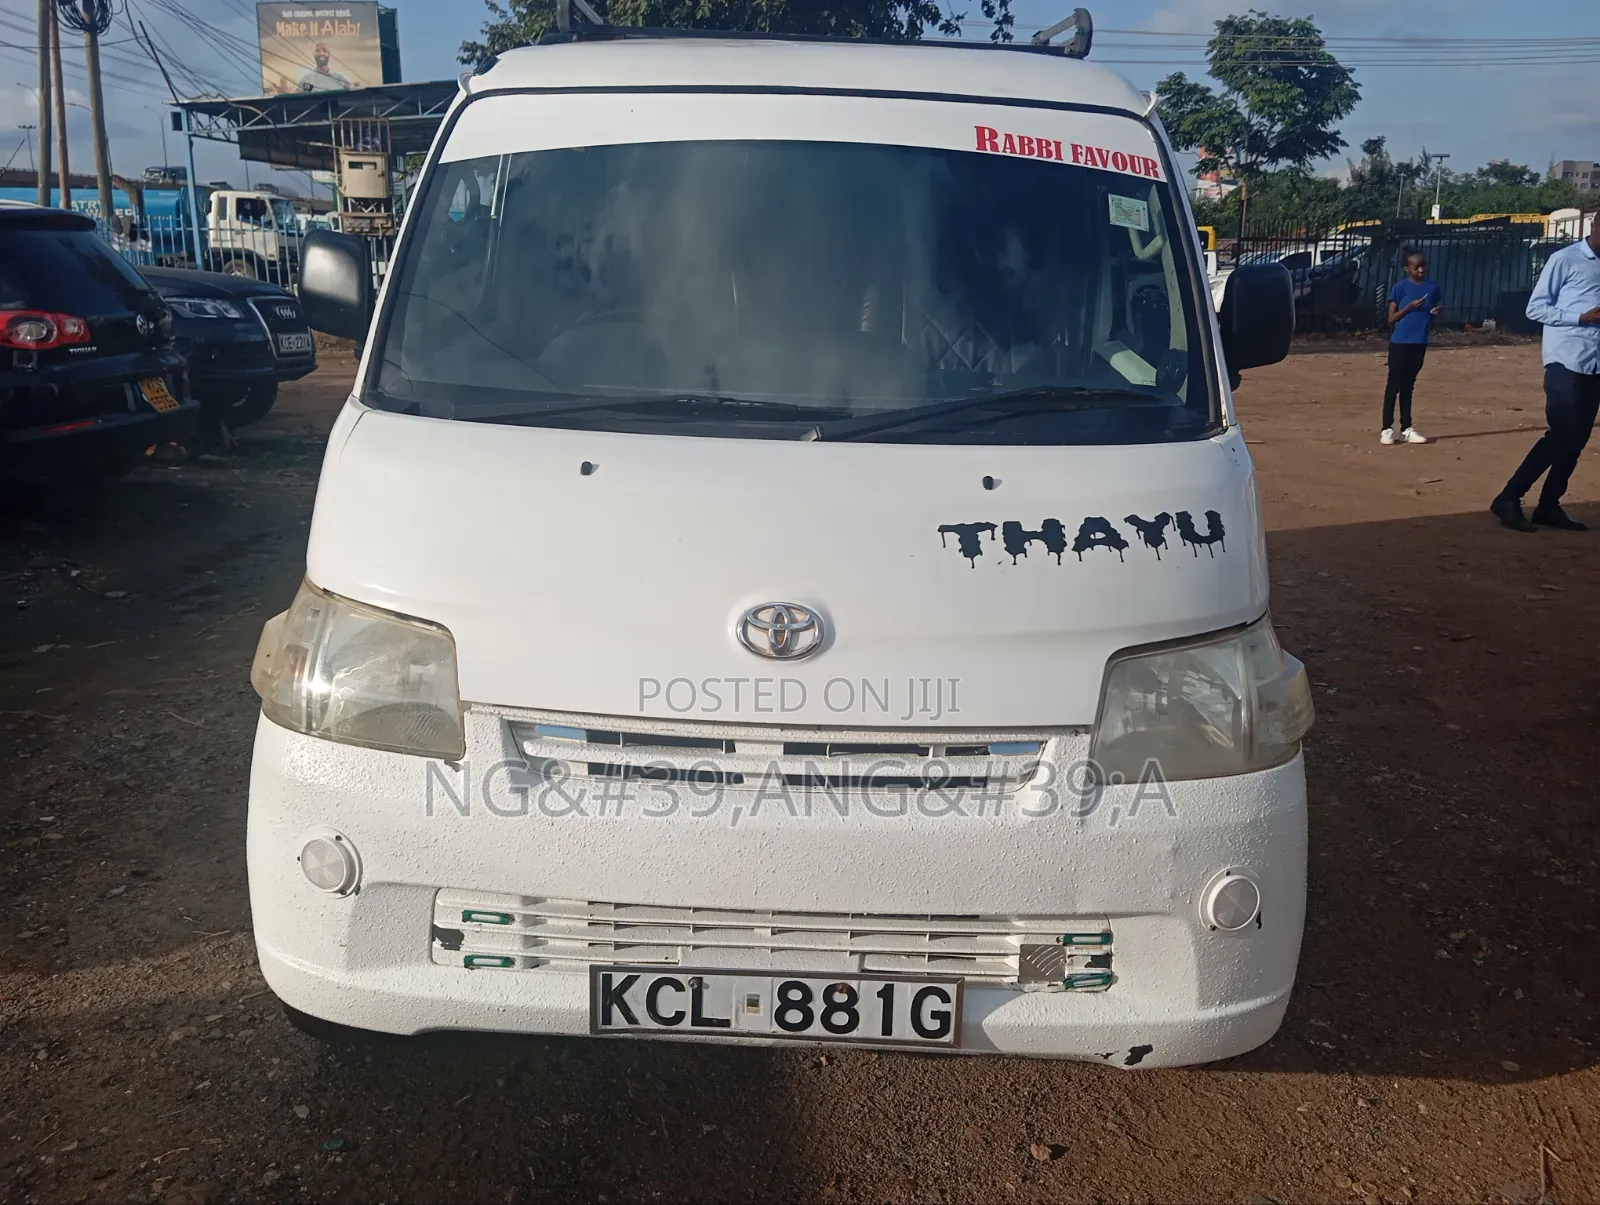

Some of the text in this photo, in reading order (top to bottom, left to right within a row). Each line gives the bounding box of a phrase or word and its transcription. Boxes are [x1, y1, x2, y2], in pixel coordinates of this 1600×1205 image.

[276, 21, 307, 37] Make
[974, 126, 1160, 179] RABBI FAVOUR
[937, 510, 1226, 569] THAYU
[601, 973, 953, 1039] KCL 881G
